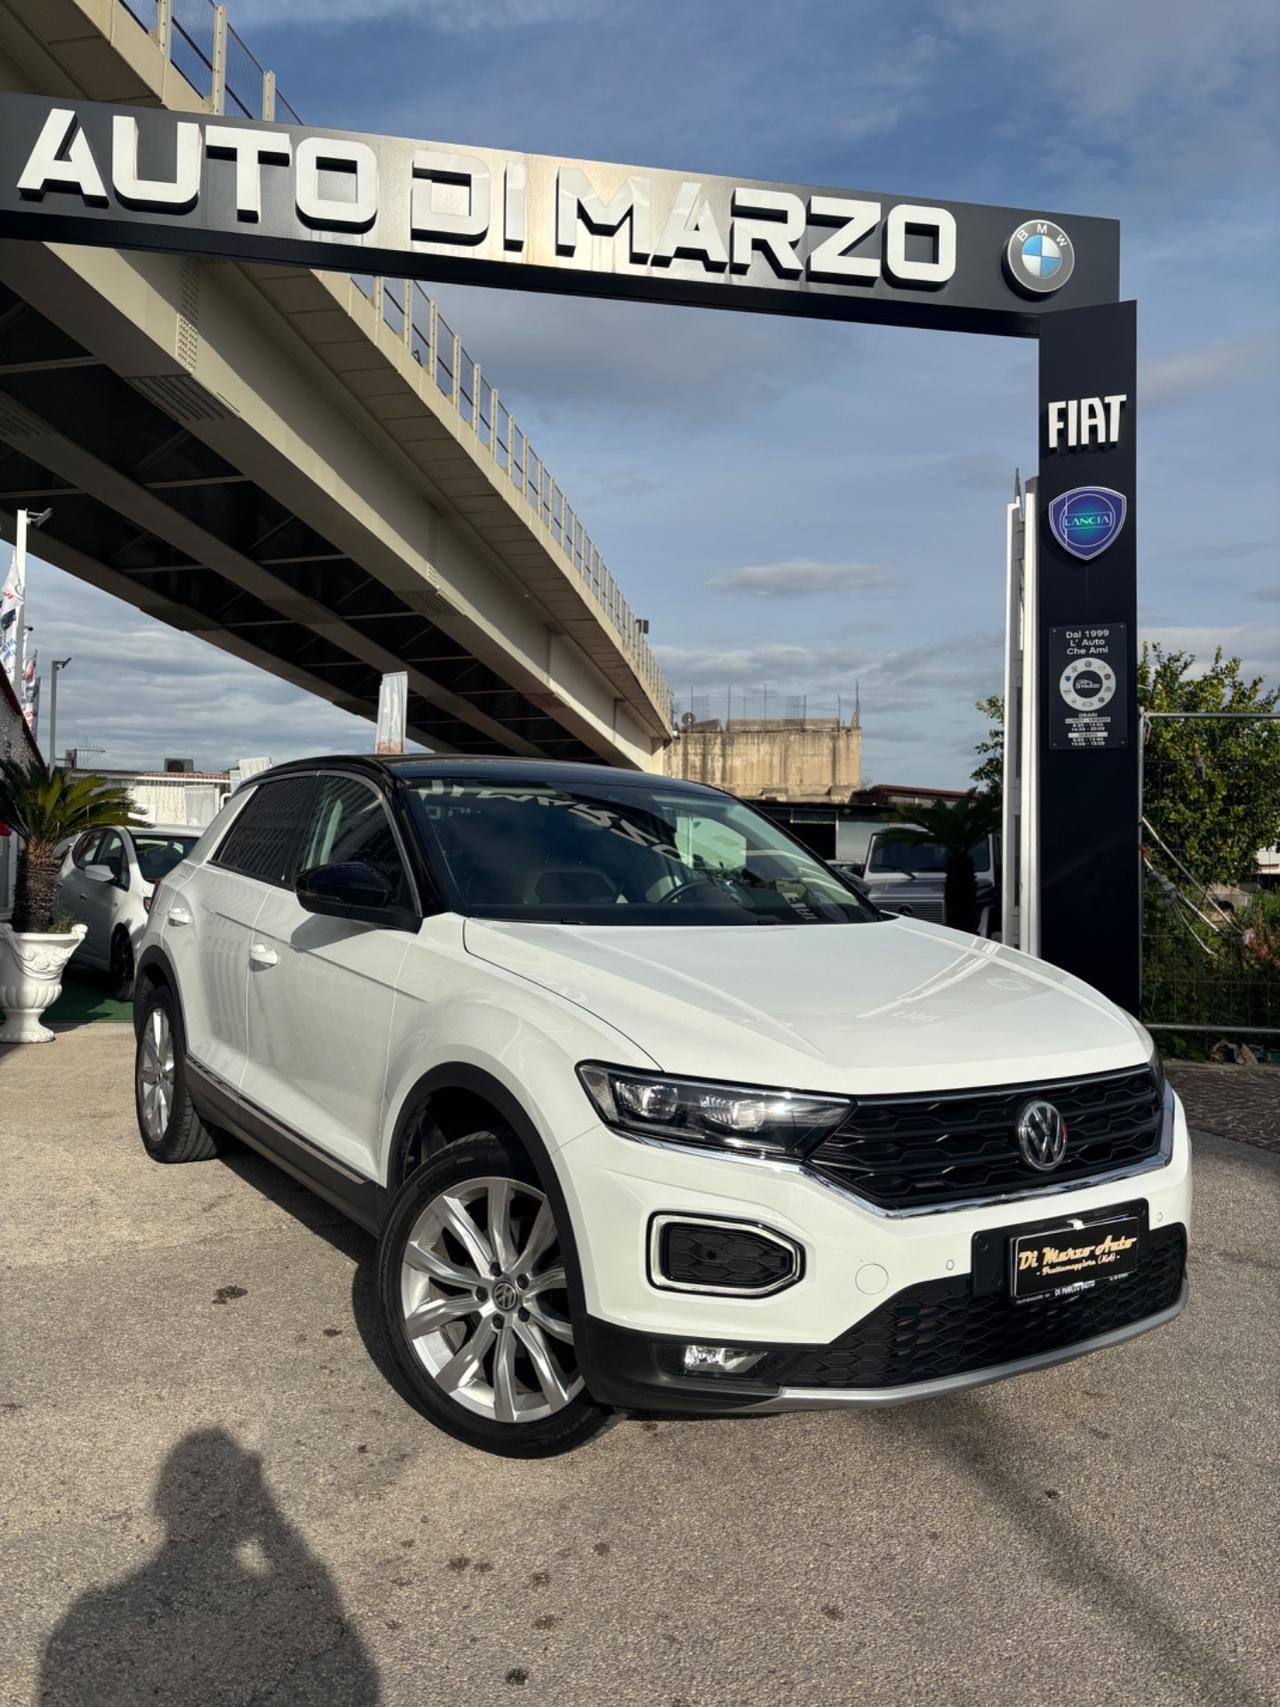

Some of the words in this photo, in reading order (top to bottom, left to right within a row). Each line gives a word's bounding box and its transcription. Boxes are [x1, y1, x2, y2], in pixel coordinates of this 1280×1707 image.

[17, 108, 378, 231] AUTO
[411, 150, 525, 249] DI
[556, 167, 957, 287] MARZO
[1017, 223, 1068, 246] BMW
[1047, 394, 1128, 447] FIAT
[1065, 515, 1110, 527] LANCIA
[1066, 630, 1081, 639] Dal
[1085, 629, 1109, 637] 1999
[1081, 638, 1105, 646] Auto
[1066, 647, 1087, 655] Che
[1089, 645, 1108, 654] Ami
[1019, 1250, 1039, 1270] Di
[1042, 1246, 1095, 1265] Marzo
[1095, 1235, 1137, 1255] Auto
